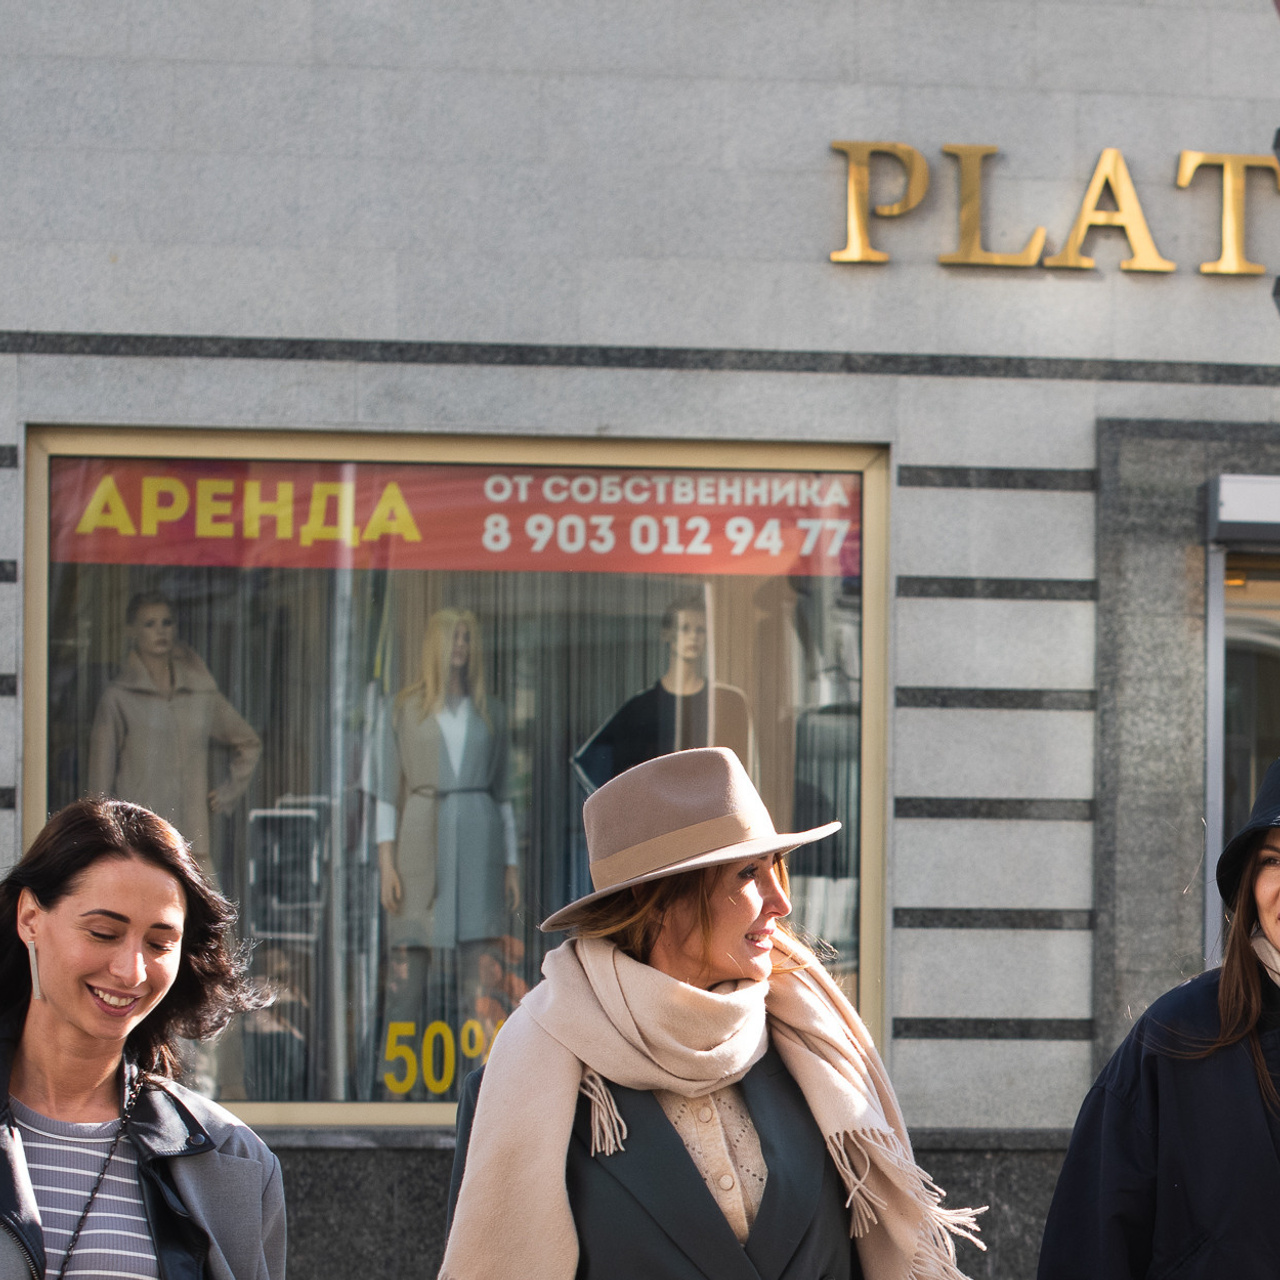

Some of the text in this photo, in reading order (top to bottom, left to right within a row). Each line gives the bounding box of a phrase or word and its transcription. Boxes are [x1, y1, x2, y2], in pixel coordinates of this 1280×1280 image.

[75, 475, 422, 547] АРЕНДА
[484, 474, 850, 507] ОТ СОБСТВЕННИКА
[482, 513, 850, 557] 8 903 012 94 77
